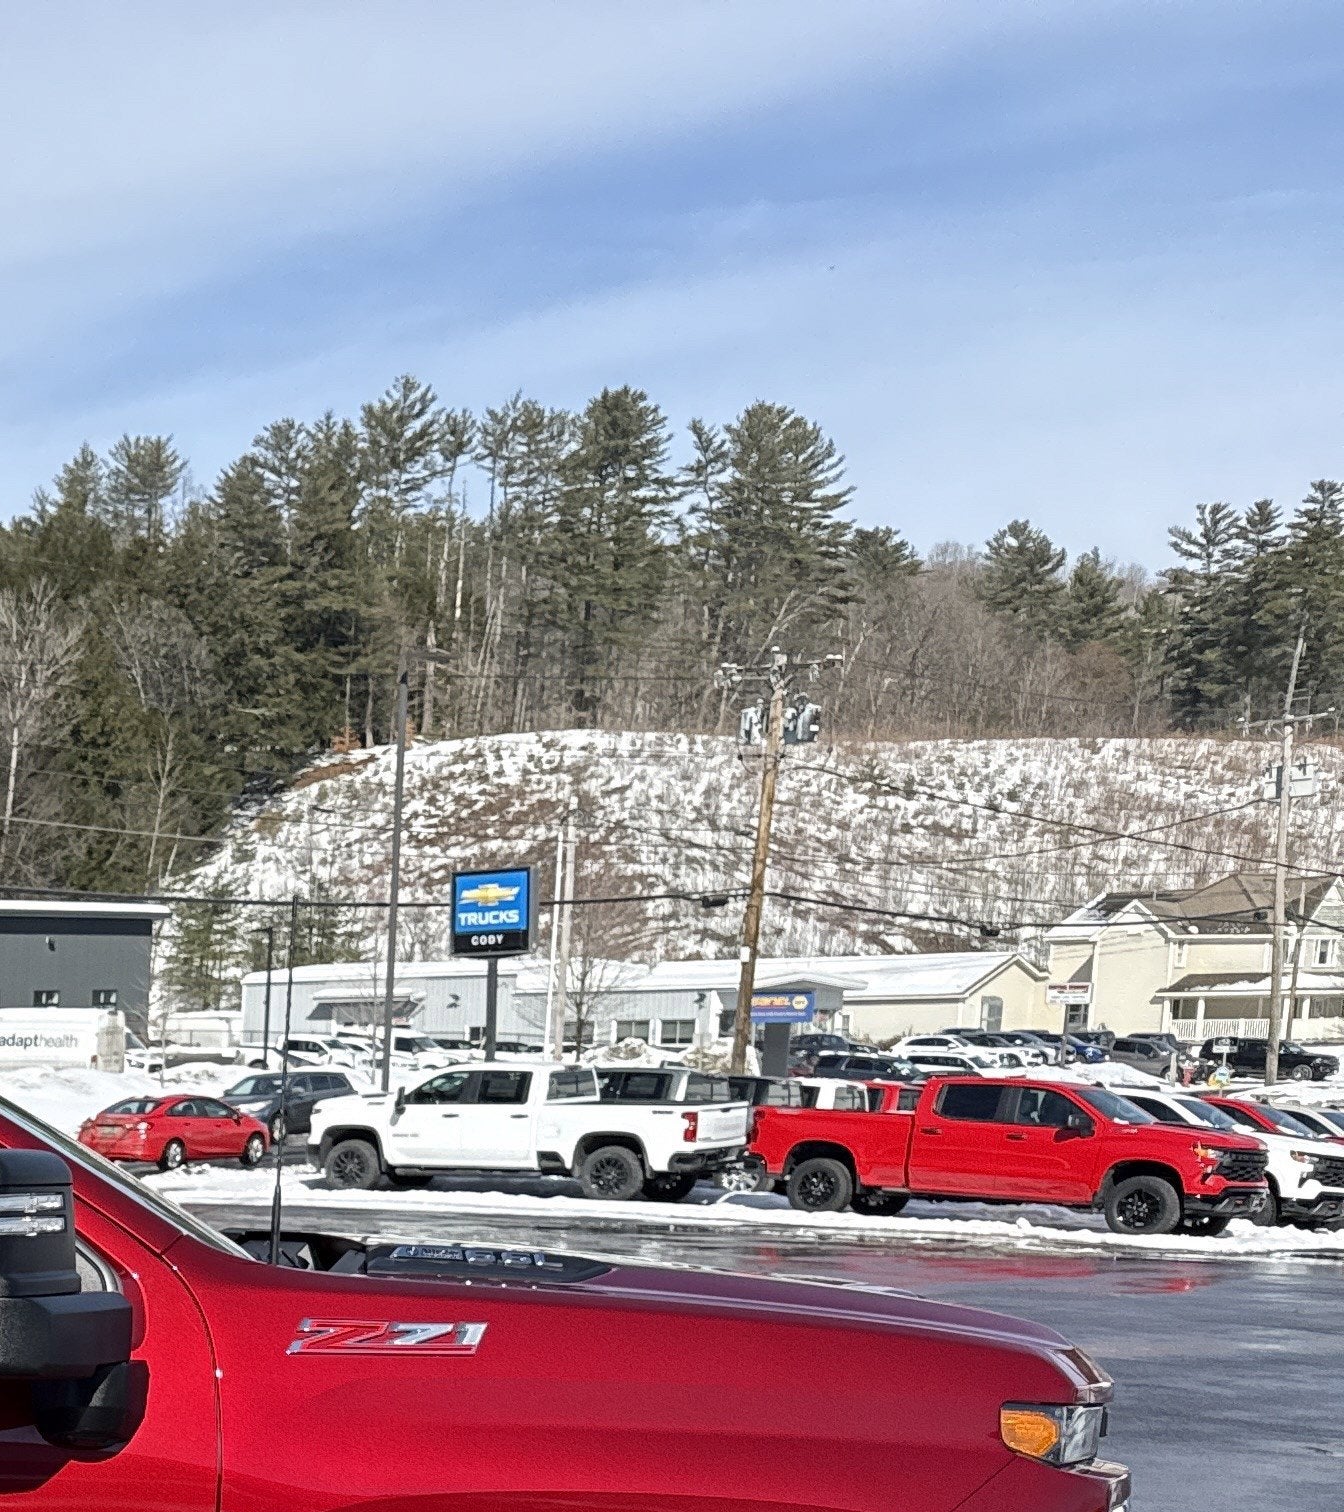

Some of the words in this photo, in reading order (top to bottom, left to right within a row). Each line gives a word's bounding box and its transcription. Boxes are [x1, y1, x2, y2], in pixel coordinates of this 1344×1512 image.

[457, 909, 520, 926] TRUCKS
[470, 933, 505, 946] CODY
[285, 1317, 488, 1356] Z71
